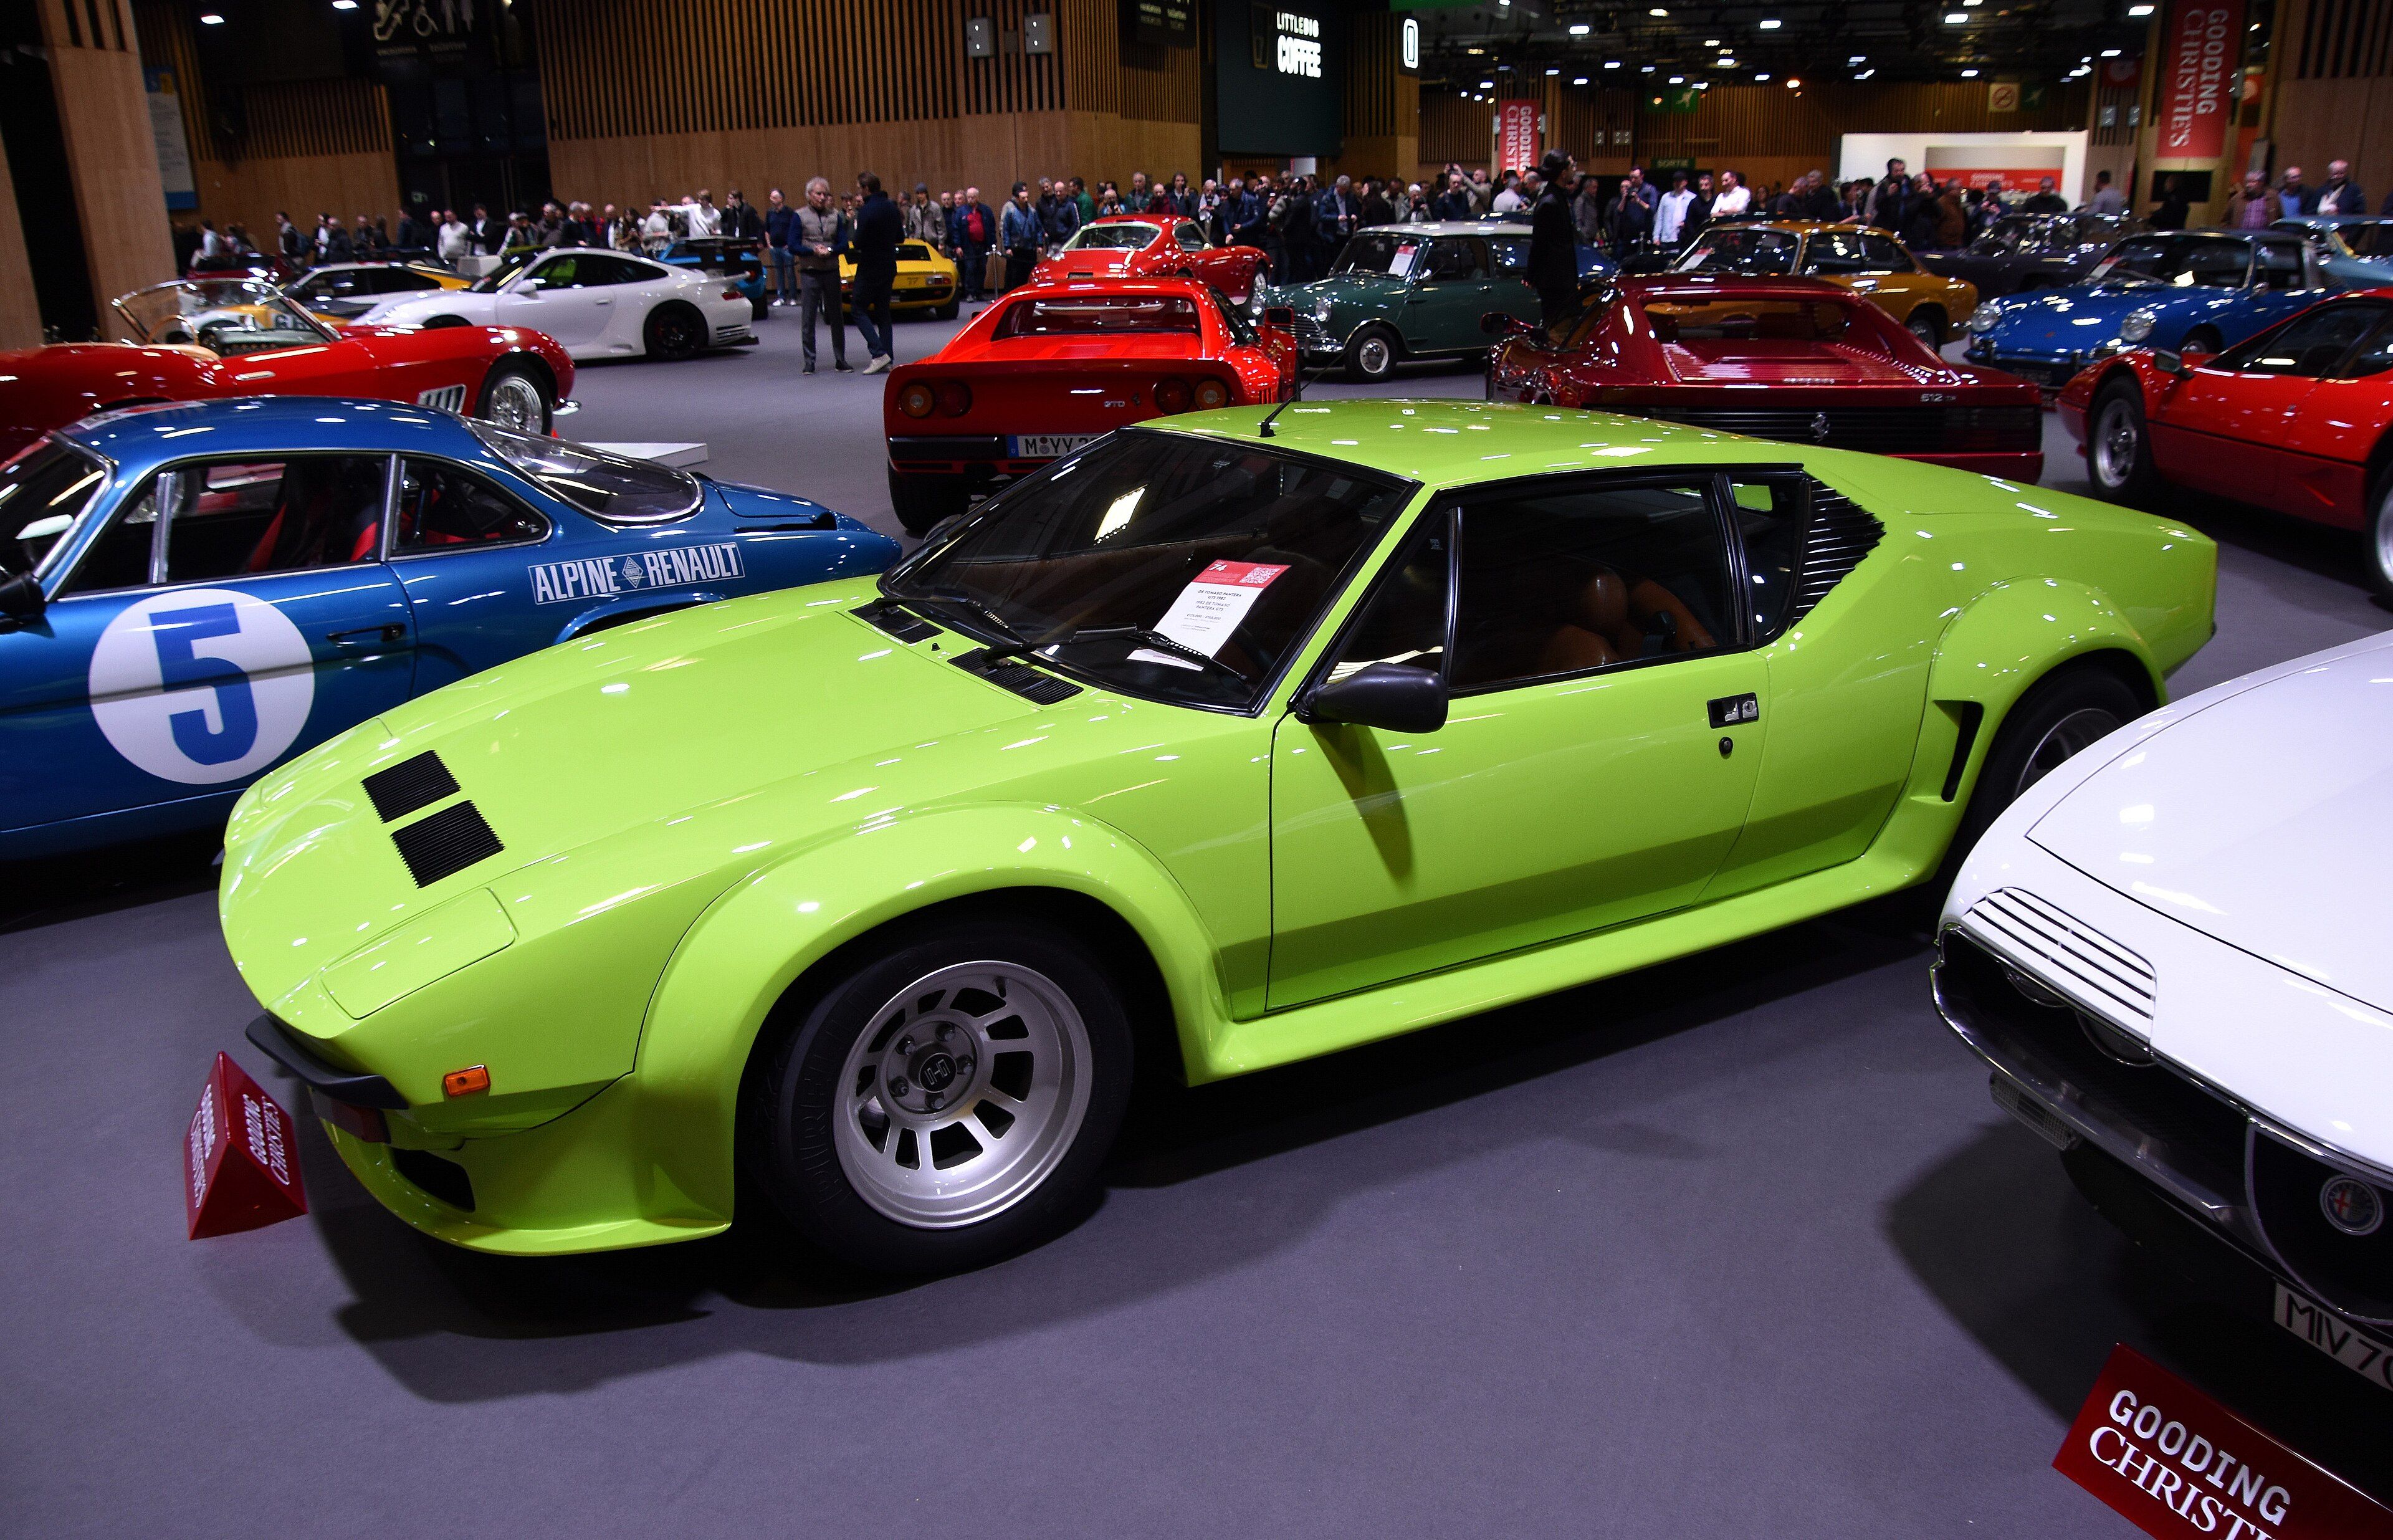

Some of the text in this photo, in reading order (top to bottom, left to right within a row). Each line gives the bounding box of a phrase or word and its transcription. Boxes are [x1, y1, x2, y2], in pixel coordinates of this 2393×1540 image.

[1277, 34, 1322, 79] COFFEE
[2169, 9, 2206, 147] CHRISTIE'S
[2196, 9, 2229, 115] GOODING
[1519, 105, 1532, 172] GOODING
[1025, 438, 1038, 454] M
[1049, 438, 1073, 454] YY
[535, 544, 739, 602] ALPINE RENAULT
[148, 602, 257, 765] 5
[2286, 1293, 2353, 1356] MIV
[2109, 1389, 2291, 1526] GOODING
